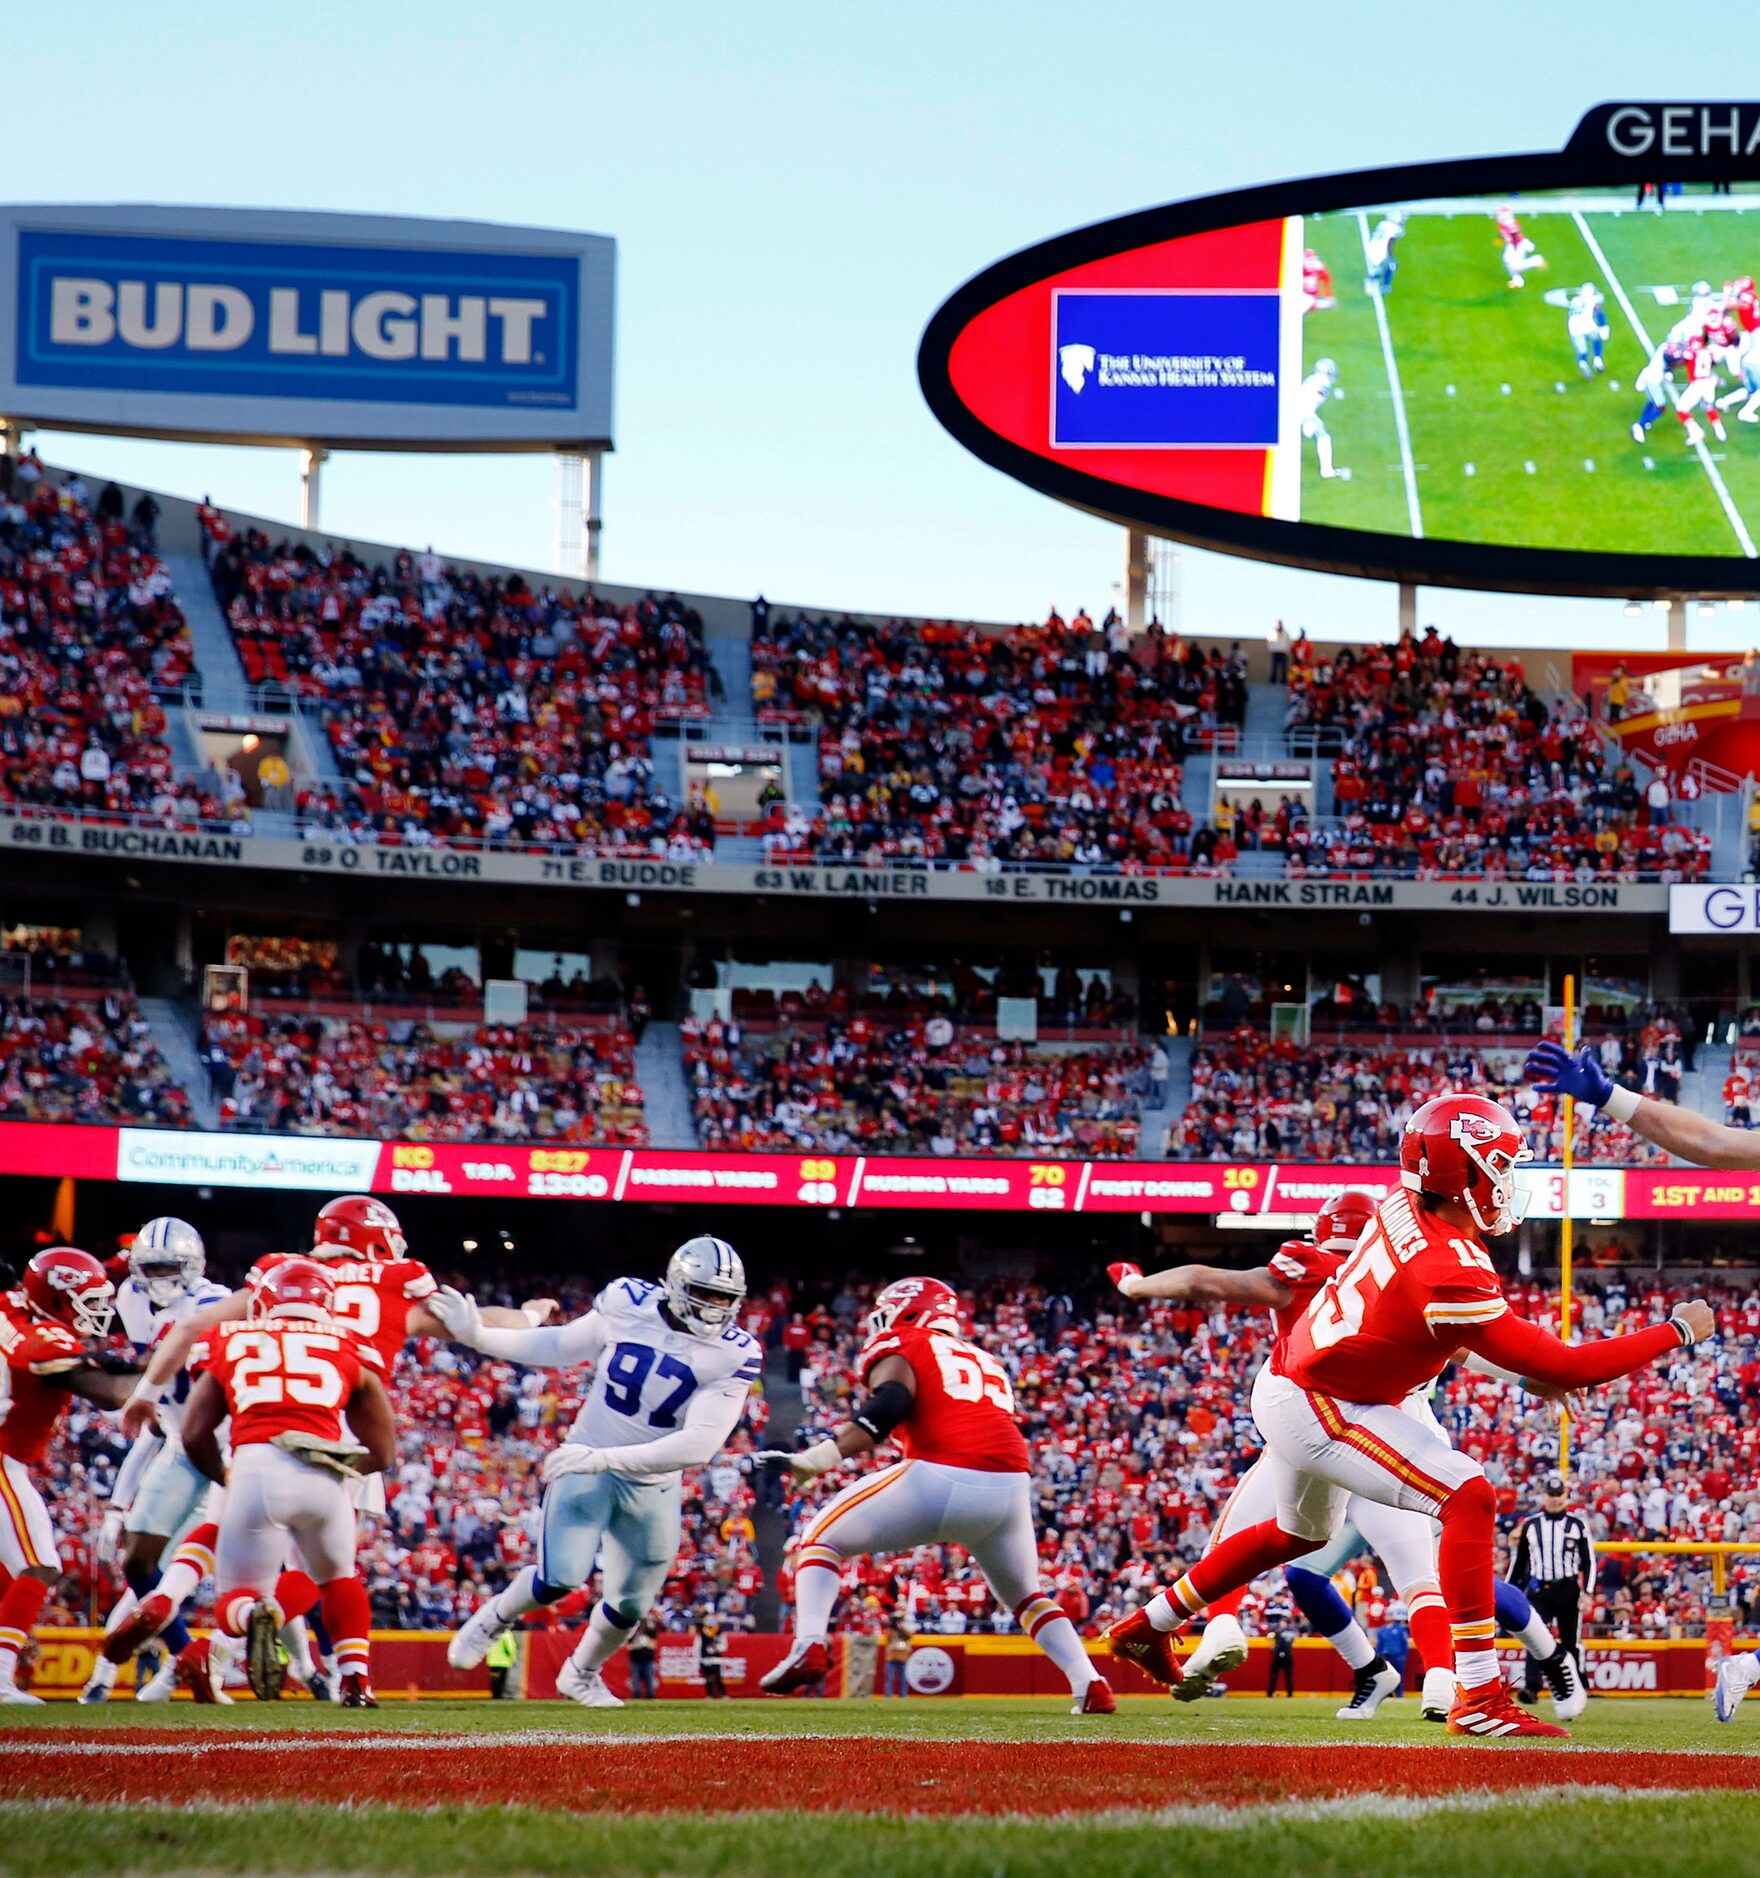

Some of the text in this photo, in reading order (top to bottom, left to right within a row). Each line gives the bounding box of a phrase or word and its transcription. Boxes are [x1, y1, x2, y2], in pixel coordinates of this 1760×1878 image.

[51, 276, 546, 364] BUD LIGHT
[50, 825, 73, 847] B.
[83, 828, 241, 861] BUCHANAN
[303, 846, 332, 866] 89
[377, 850, 480, 877] TAYLOR
[542, 860, 695, 886] 71 E. BUDDE
[754, 870, 928, 895] 63 W. LANIER
[986, 878, 1158, 900] 18 E. THOMAS
[1215, 881, 1393, 905] HANK STRAM
[1451, 886, 1618, 907] 44 J. WILSON
[393, 1146, 434, 1168] KC
[391, 1169, 452, 1192] DAL
[631, 1168, 778, 1188] PASSING YARDS
[863, 1175, 1009, 1194] RUSHING YARDS
[1029, 1165, 1065, 1185] 70
[1223, 1168, 1258, 1188] 10
[797, 1182, 837, 1204] 49
[1028, 1187, 1065, 1209] 62
[1090, 1180, 1213, 1197] FIRST DOWNS
[1548, 1177, 1564, 1212] 3
[1652, 1187, 1699, 1206] 1ST
[1702, 1188, 1744, 1203] AND
[1230, 1190, 1249, 1211] 6
[1592, 1193, 1606, 1209] 3
[226, 1331, 343, 1413] 25
[605, 1341, 698, 1428] 97
